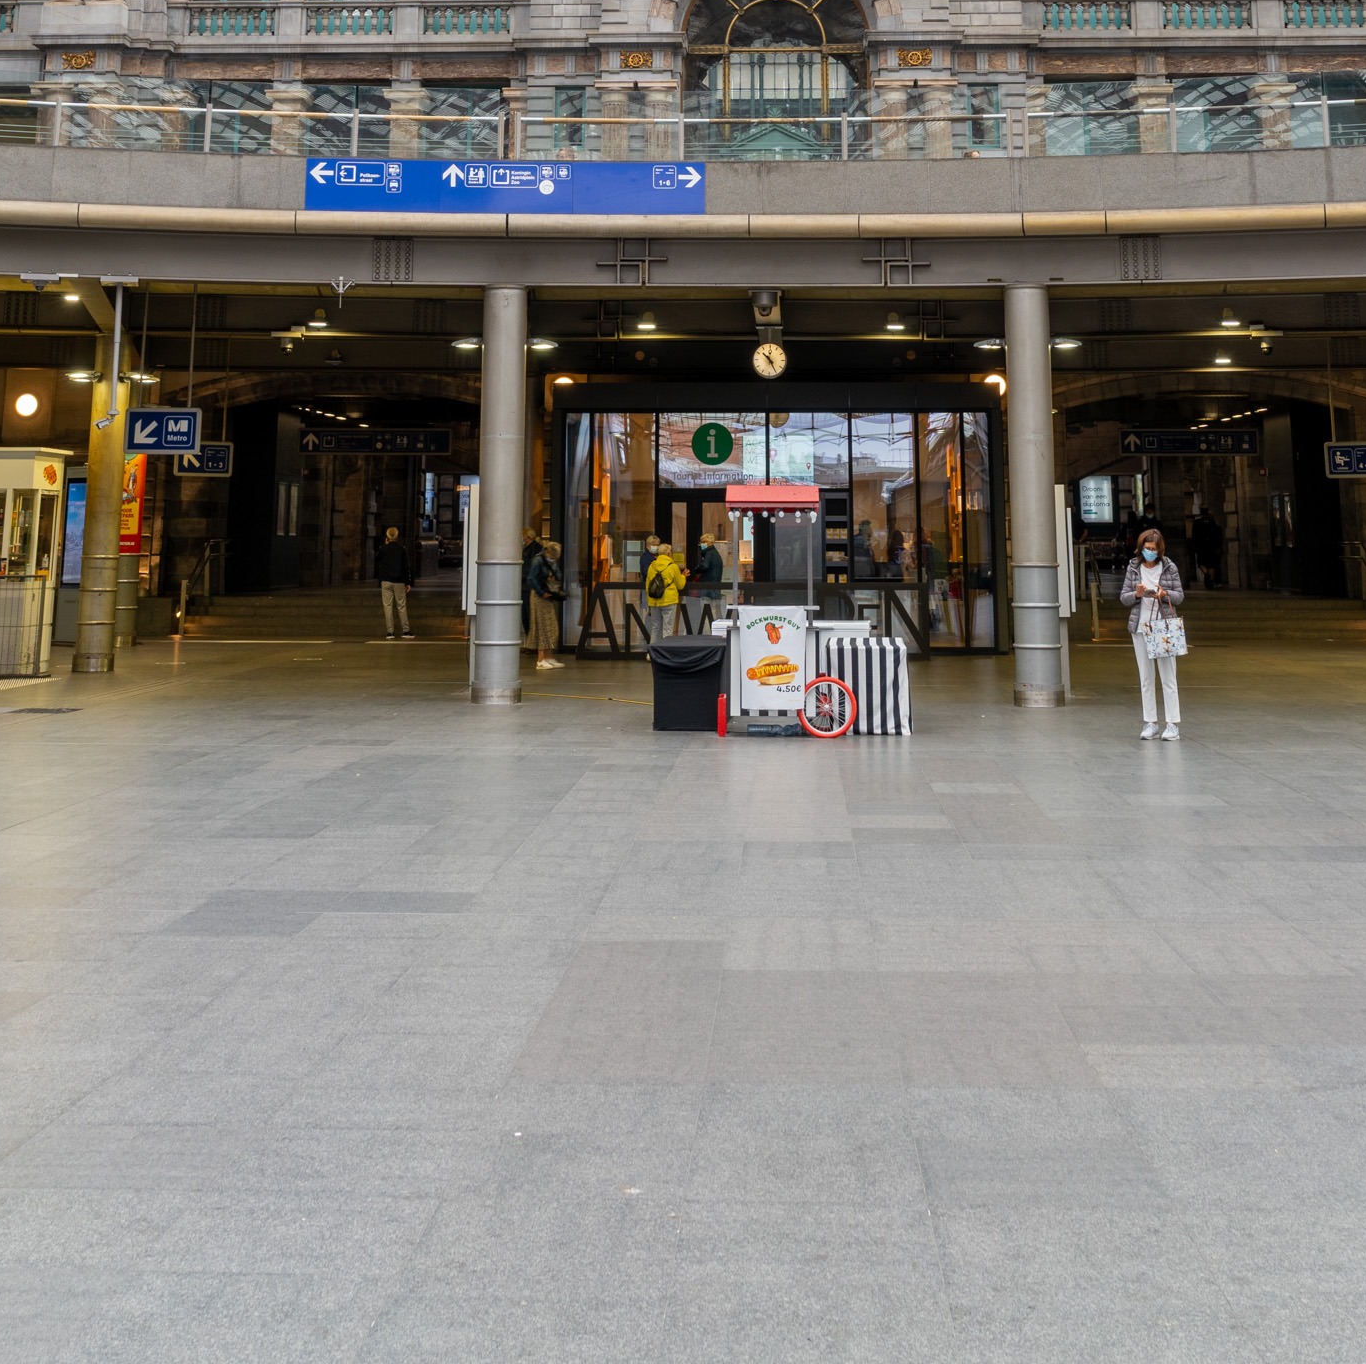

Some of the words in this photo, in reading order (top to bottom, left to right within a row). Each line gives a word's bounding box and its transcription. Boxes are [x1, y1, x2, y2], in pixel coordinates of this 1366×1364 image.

[704, 472, 754, 481] Information
[1083, 500, 1110, 508] diploma
[746, 616, 787, 630] BOCKWURST
[787, 619, 801, 630] GUY
[777, 685, 801, 693] 4.50€
